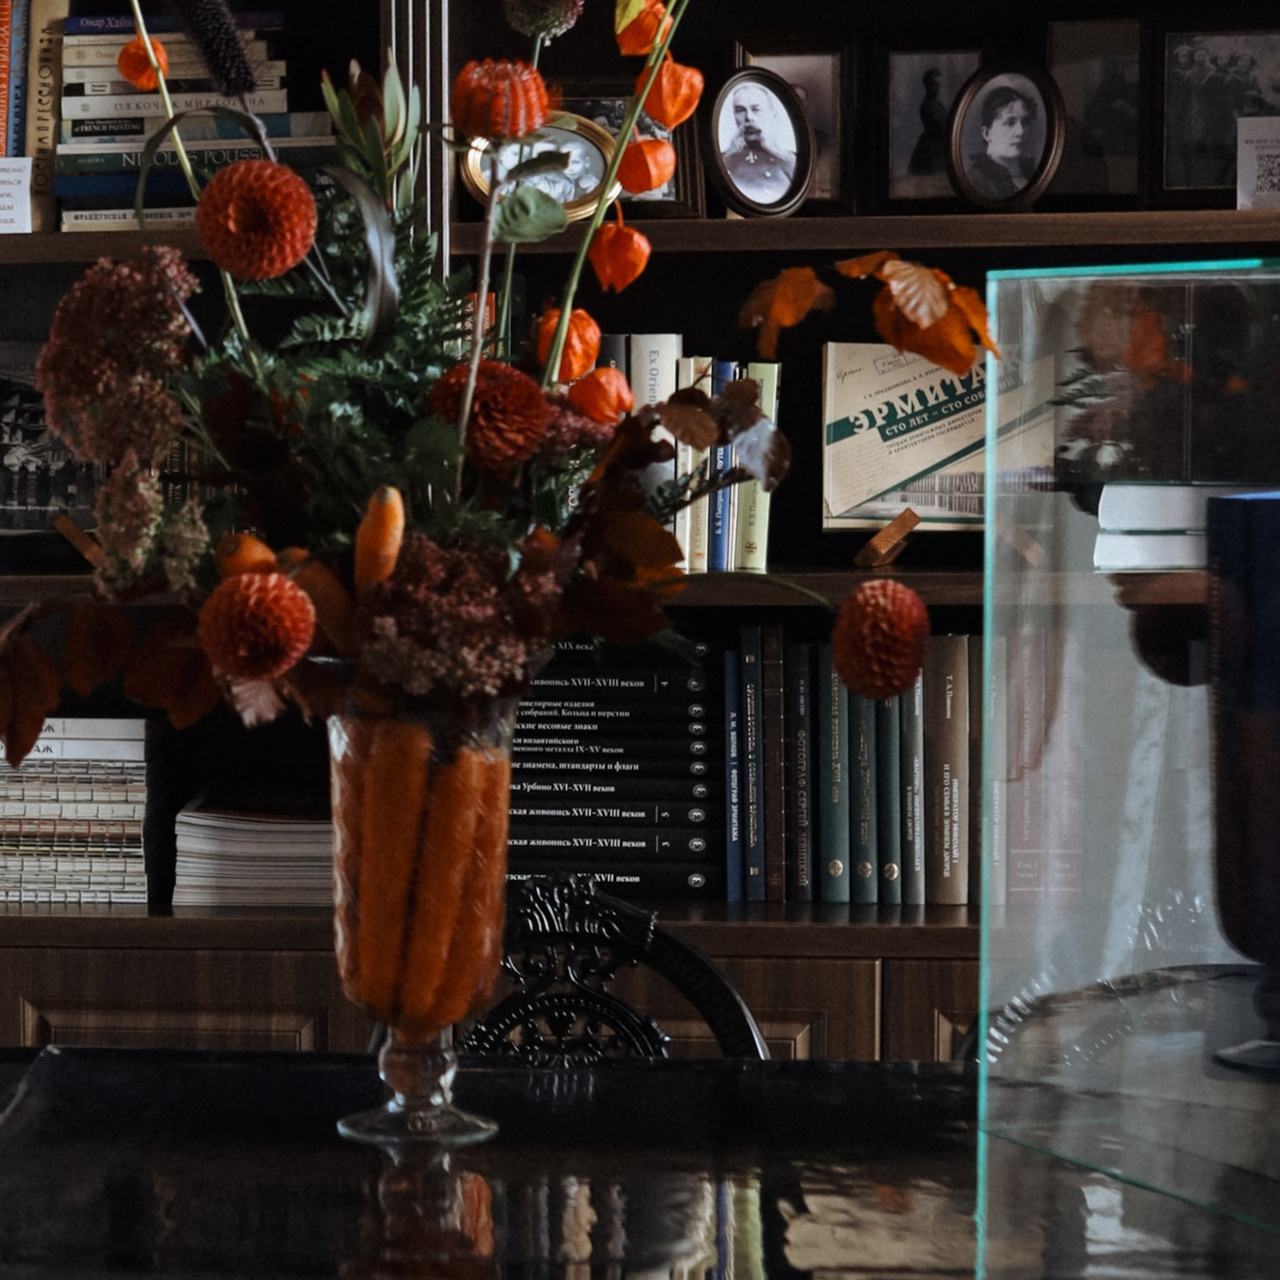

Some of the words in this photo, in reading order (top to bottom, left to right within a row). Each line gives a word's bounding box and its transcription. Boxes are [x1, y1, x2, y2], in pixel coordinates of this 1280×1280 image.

[849, 361, 987, 435] ЭРМИТА
[885, 421, 907, 437] СТО
[908, 412, 930, 431] ЛЕТ
[941, 399, 963, 416] СТО
[557, 641, 575, 650] XIX
[561, 709, 590, 718] Кольца
[597, 710, 630, 719] перстни
[523, 737, 579, 746] византийского
[730, 731, 739, 758] ВОЛКОВ
[518, 761, 558, 770] знамена,
[558, 762, 605, 771] штандарты
[613, 761, 639, 773] флаги
[796, 730, 809, 788] ФОТОГРАФ
[522, 782, 552, 793] Урбино
[731, 769, 740, 803] ФОТОГРАФ
[942, 772, 951, 786] ЕГО
[529, 809, 571, 818] живопись
[621, 810, 646, 818] веков
[797, 790, 809, 826] СЕРГЕЙ
[950, 778, 960, 821] ИМПЕРАТОР
[731, 804, 740, 842] ЭРМИТАЖА
[941, 817, 951, 849] ЗИМНЕМ
[529, 839, 571, 848] живопись
[622, 840, 646, 848] веков
[950, 822, 961, 859] НИКОЛАЙ
[797, 830, 809, 887] ЛЕВИЦКИЙ
[616, 874, 641, 883] веков
